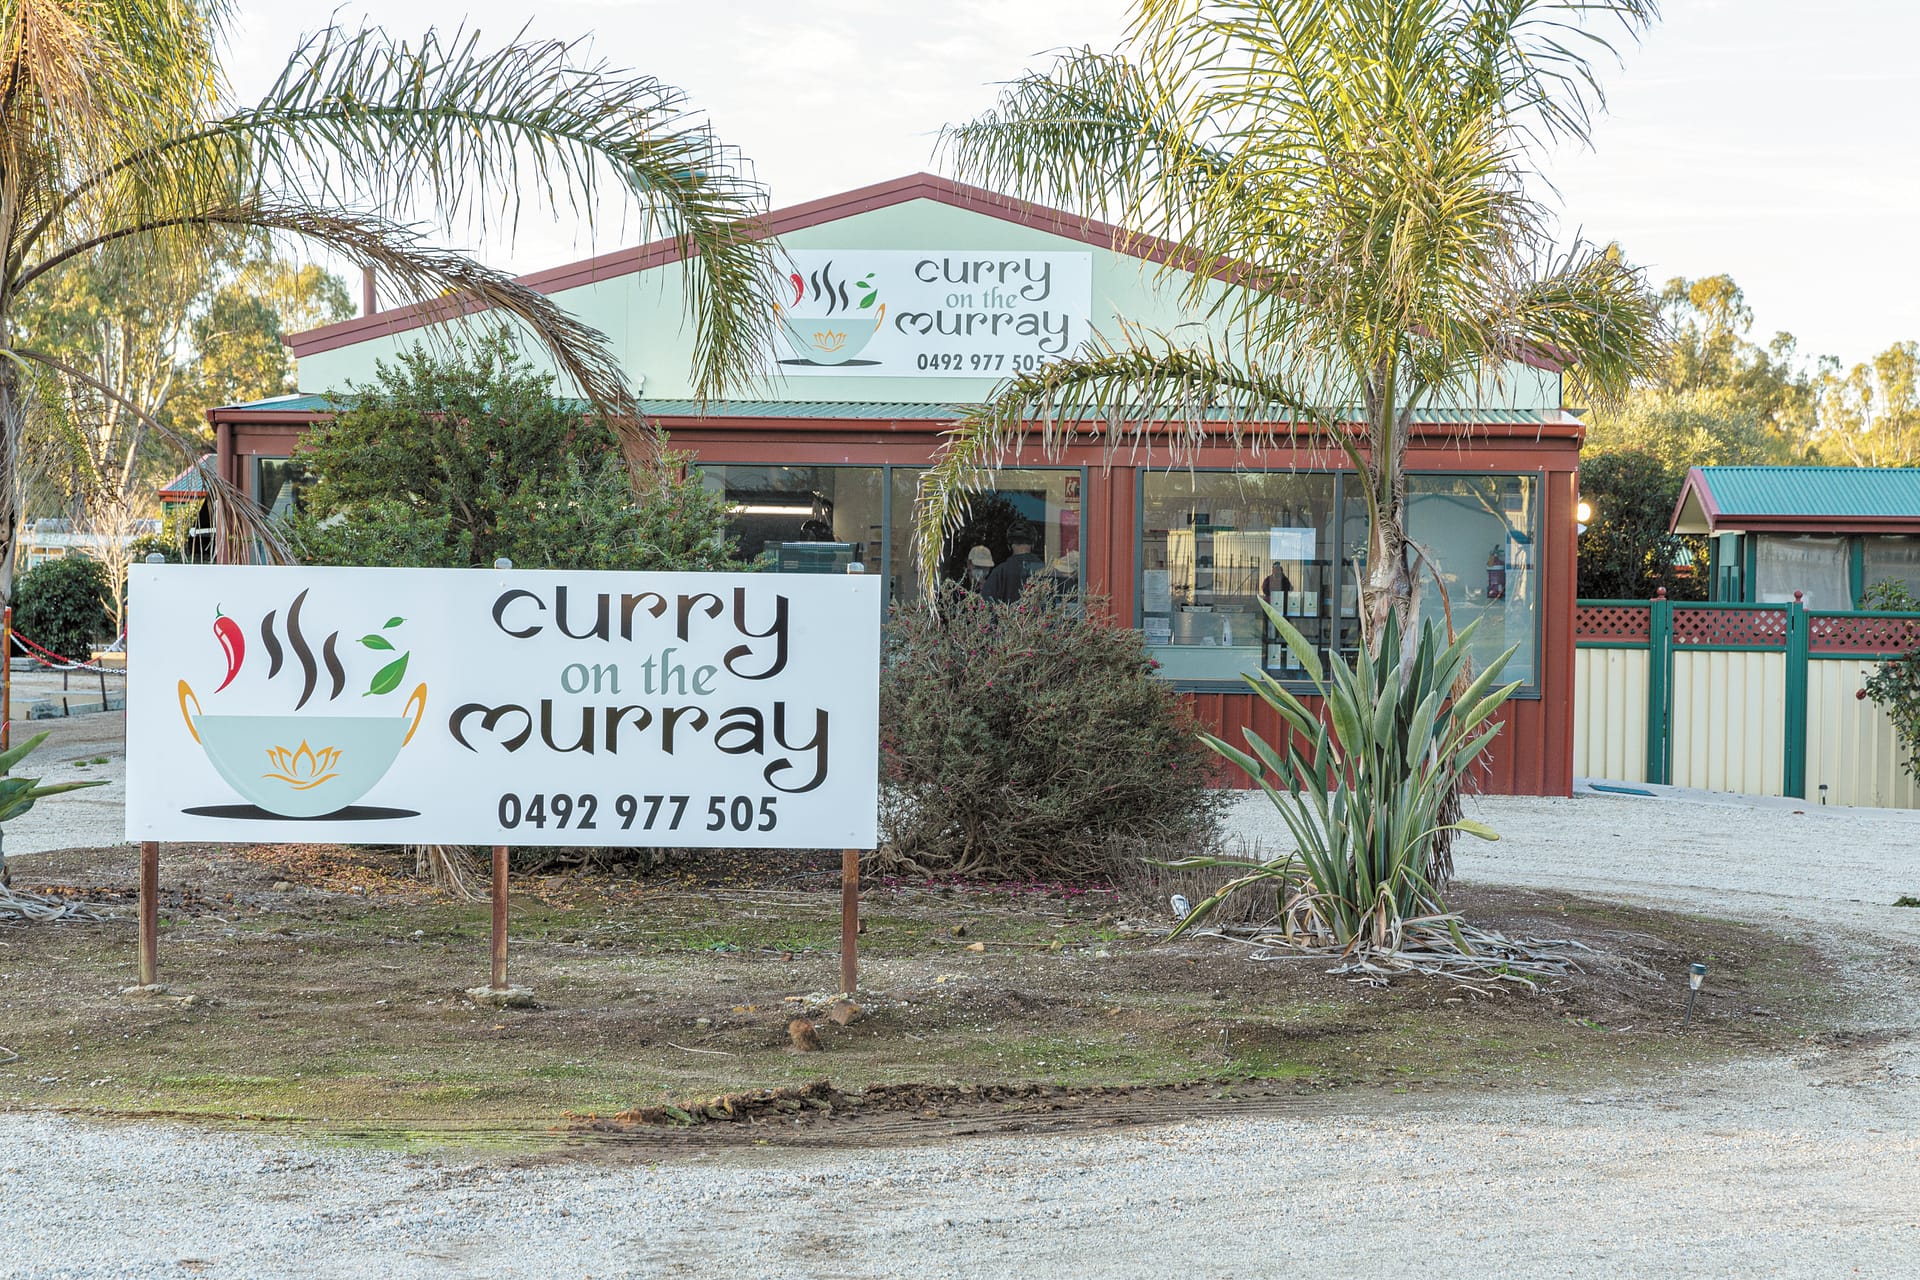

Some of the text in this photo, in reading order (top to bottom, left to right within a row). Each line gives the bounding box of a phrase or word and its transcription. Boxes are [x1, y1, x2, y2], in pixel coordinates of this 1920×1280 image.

[915, 258, 1051, 302] curry
[946, 286, 1018, 309] on the
[895, 310, 1069, 354] murray
[917, 353, 1045, 371] 0492 977 505
[492, 586, 790, 681] curry
[560, 647, 718, 696] on the
[449, 698, 829, 794] murray
[498, 792, 778, 832] 0492 977 505
